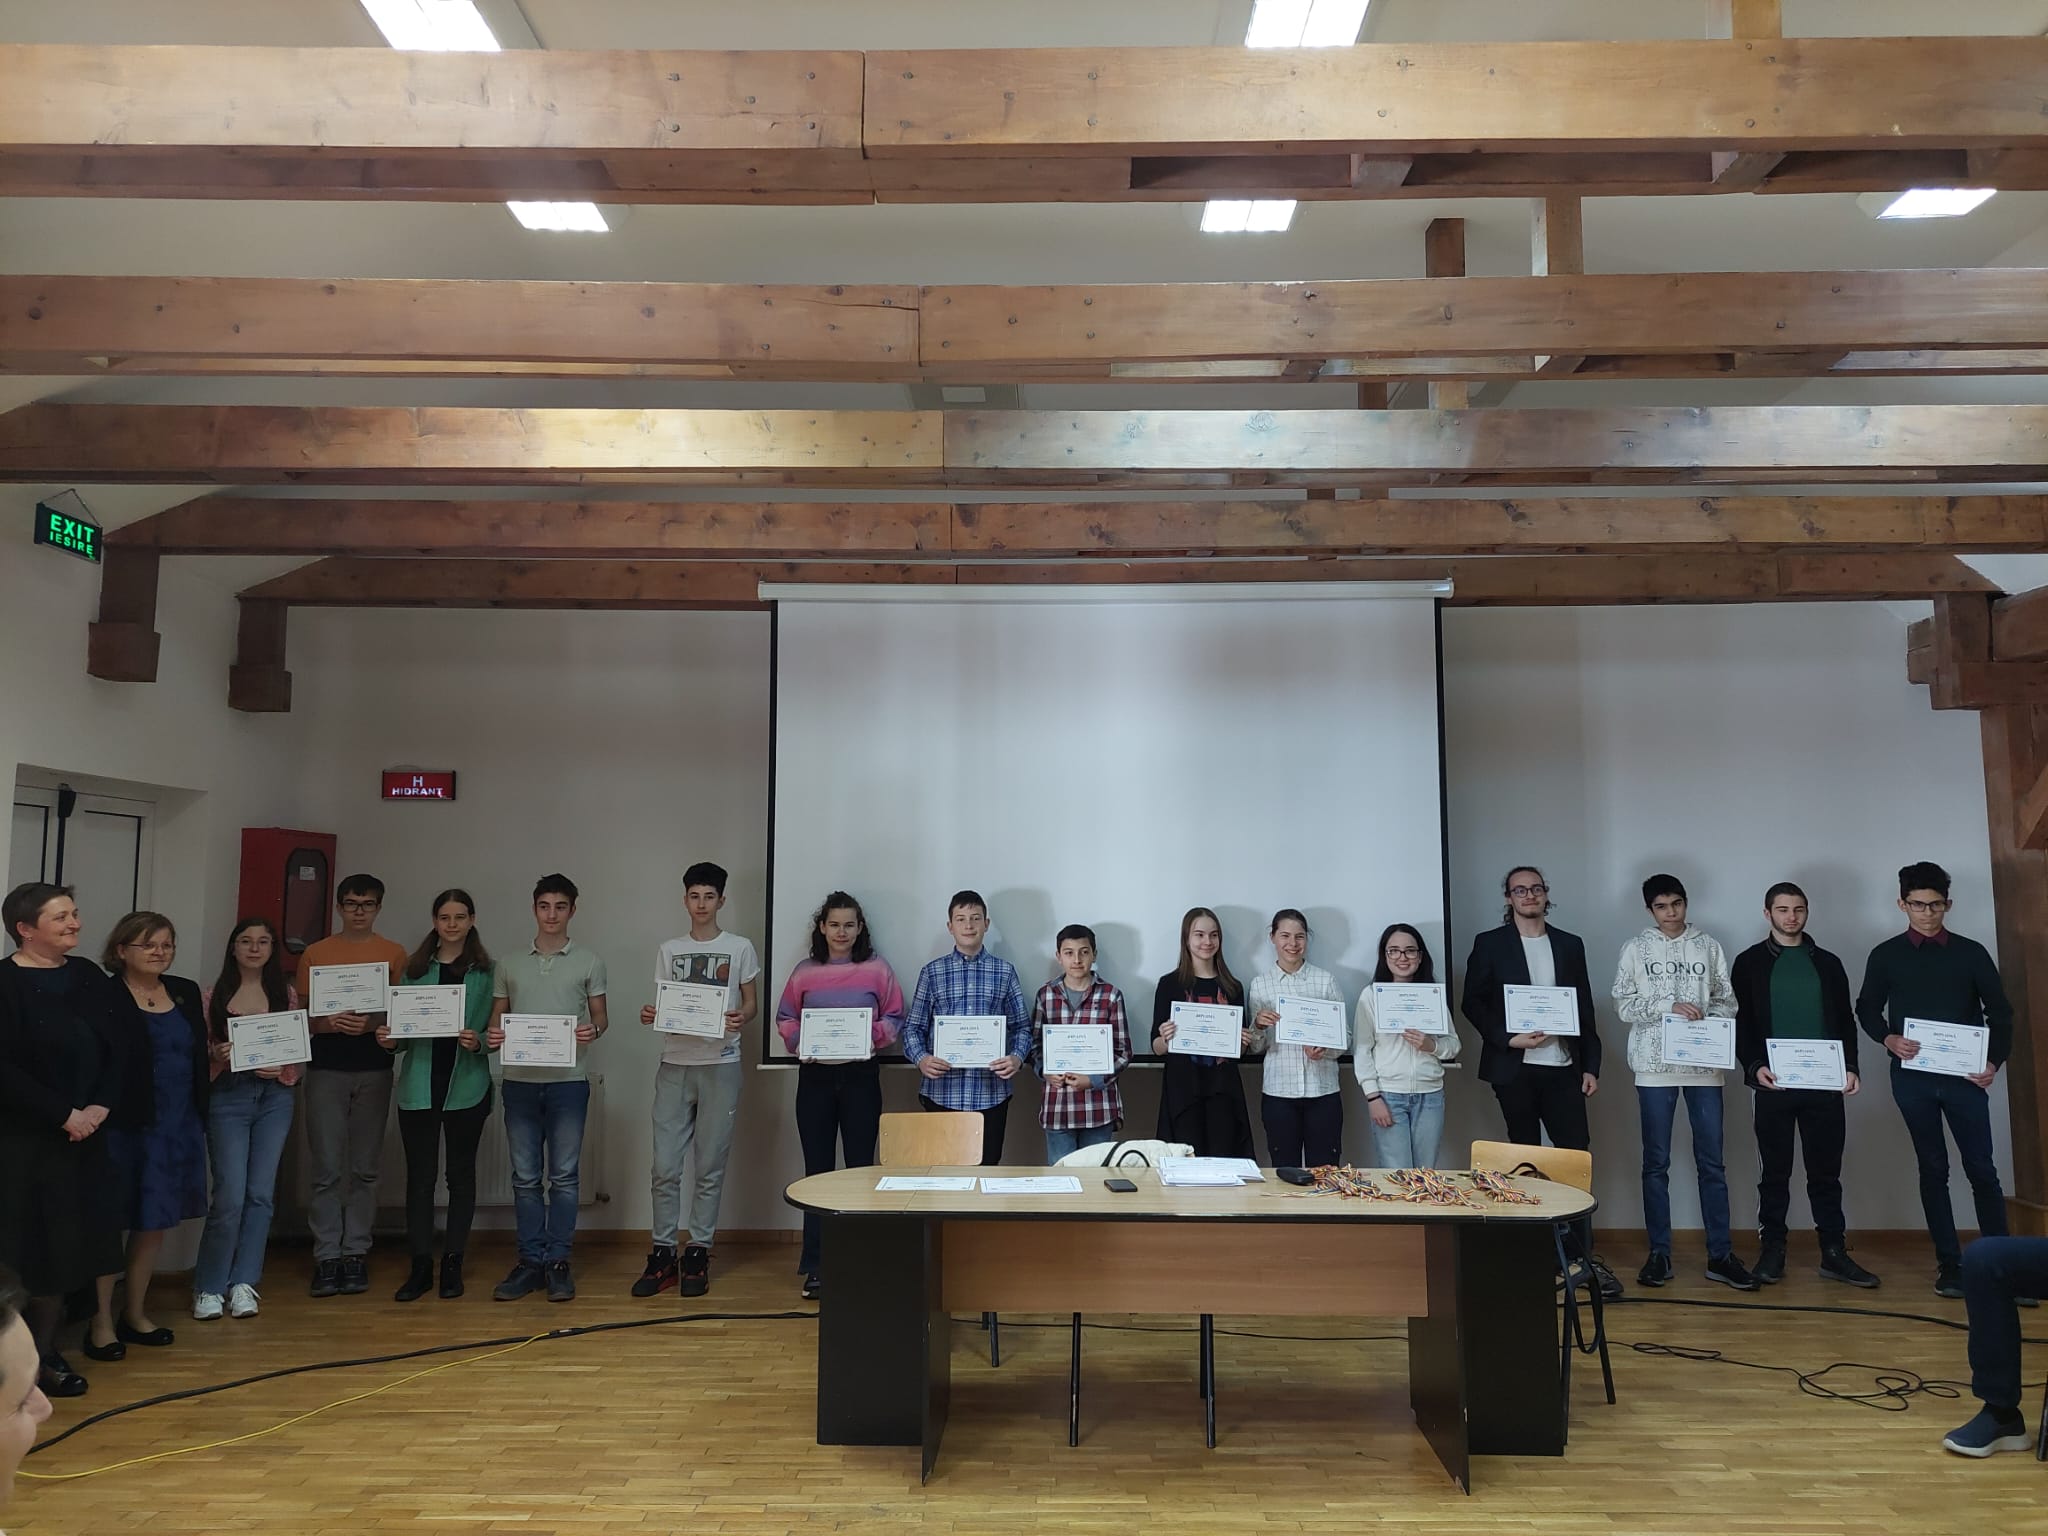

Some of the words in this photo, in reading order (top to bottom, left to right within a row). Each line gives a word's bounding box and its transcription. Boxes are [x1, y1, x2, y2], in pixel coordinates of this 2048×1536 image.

[51, 513, 94, 543] EXIT
[50, 531, 94, 555] IESIRE
[413, 775, 424, 787] H
[392, 787, 443, 797] HIDRANT
[672, 957, 730, 981] SLM
[1645, 961, 1706, 976] ICONO
